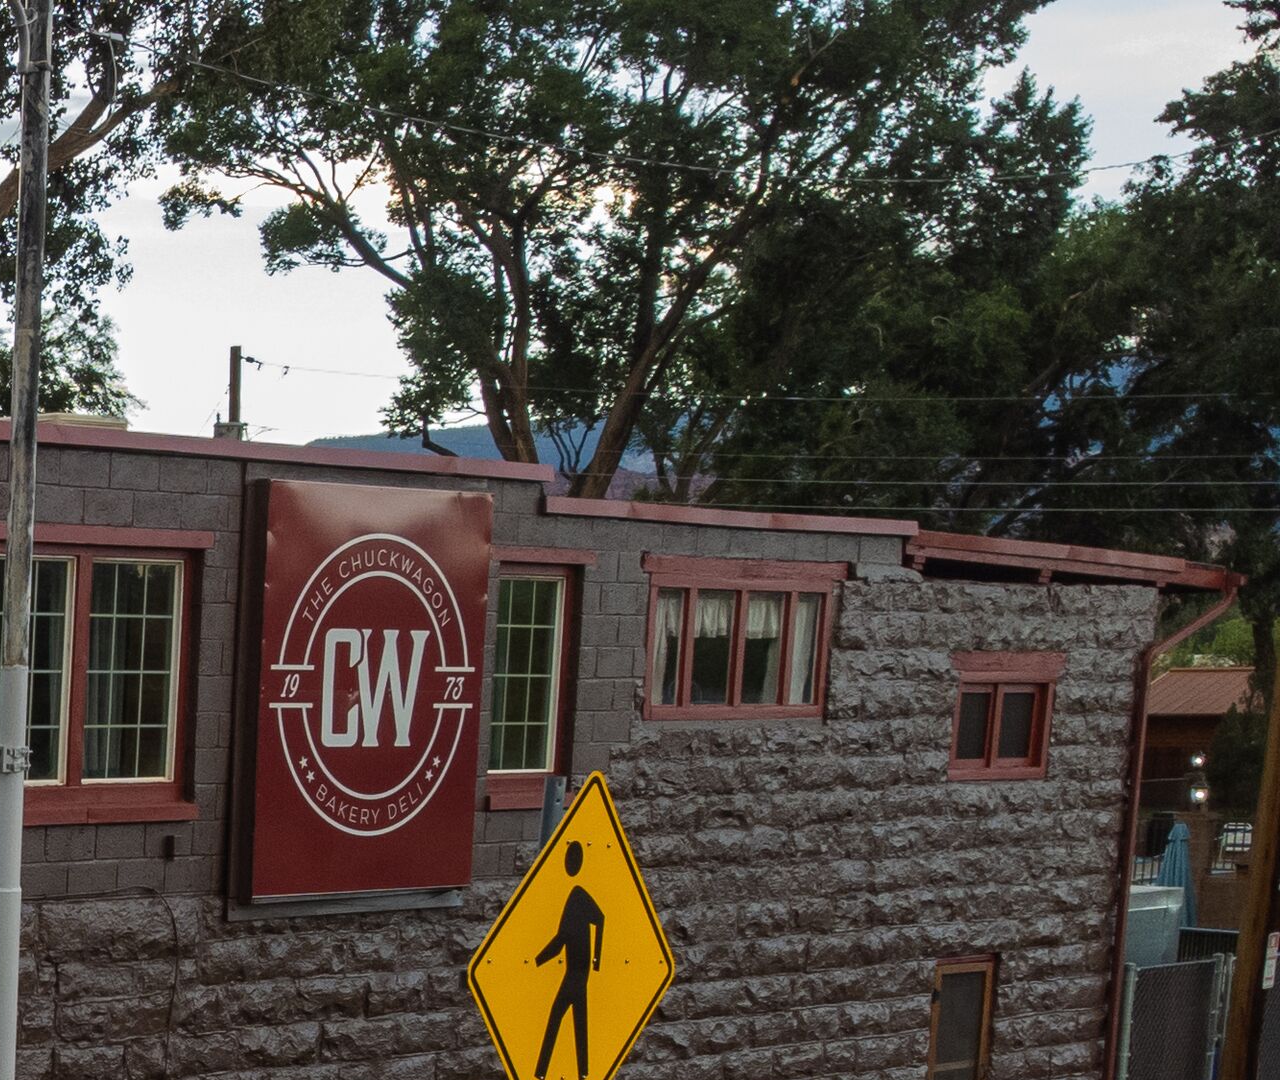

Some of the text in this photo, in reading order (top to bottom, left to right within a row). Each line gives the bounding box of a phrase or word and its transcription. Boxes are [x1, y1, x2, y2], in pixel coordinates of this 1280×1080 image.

[302, 549, 451, 628] THE CHUCKWAGON
[280, 673, 300, 698] 19
[320, 628, 431, 747] CW
[443, 676, 465, 700] 73
[315, 783, 423, 824] BAKERY DELI
